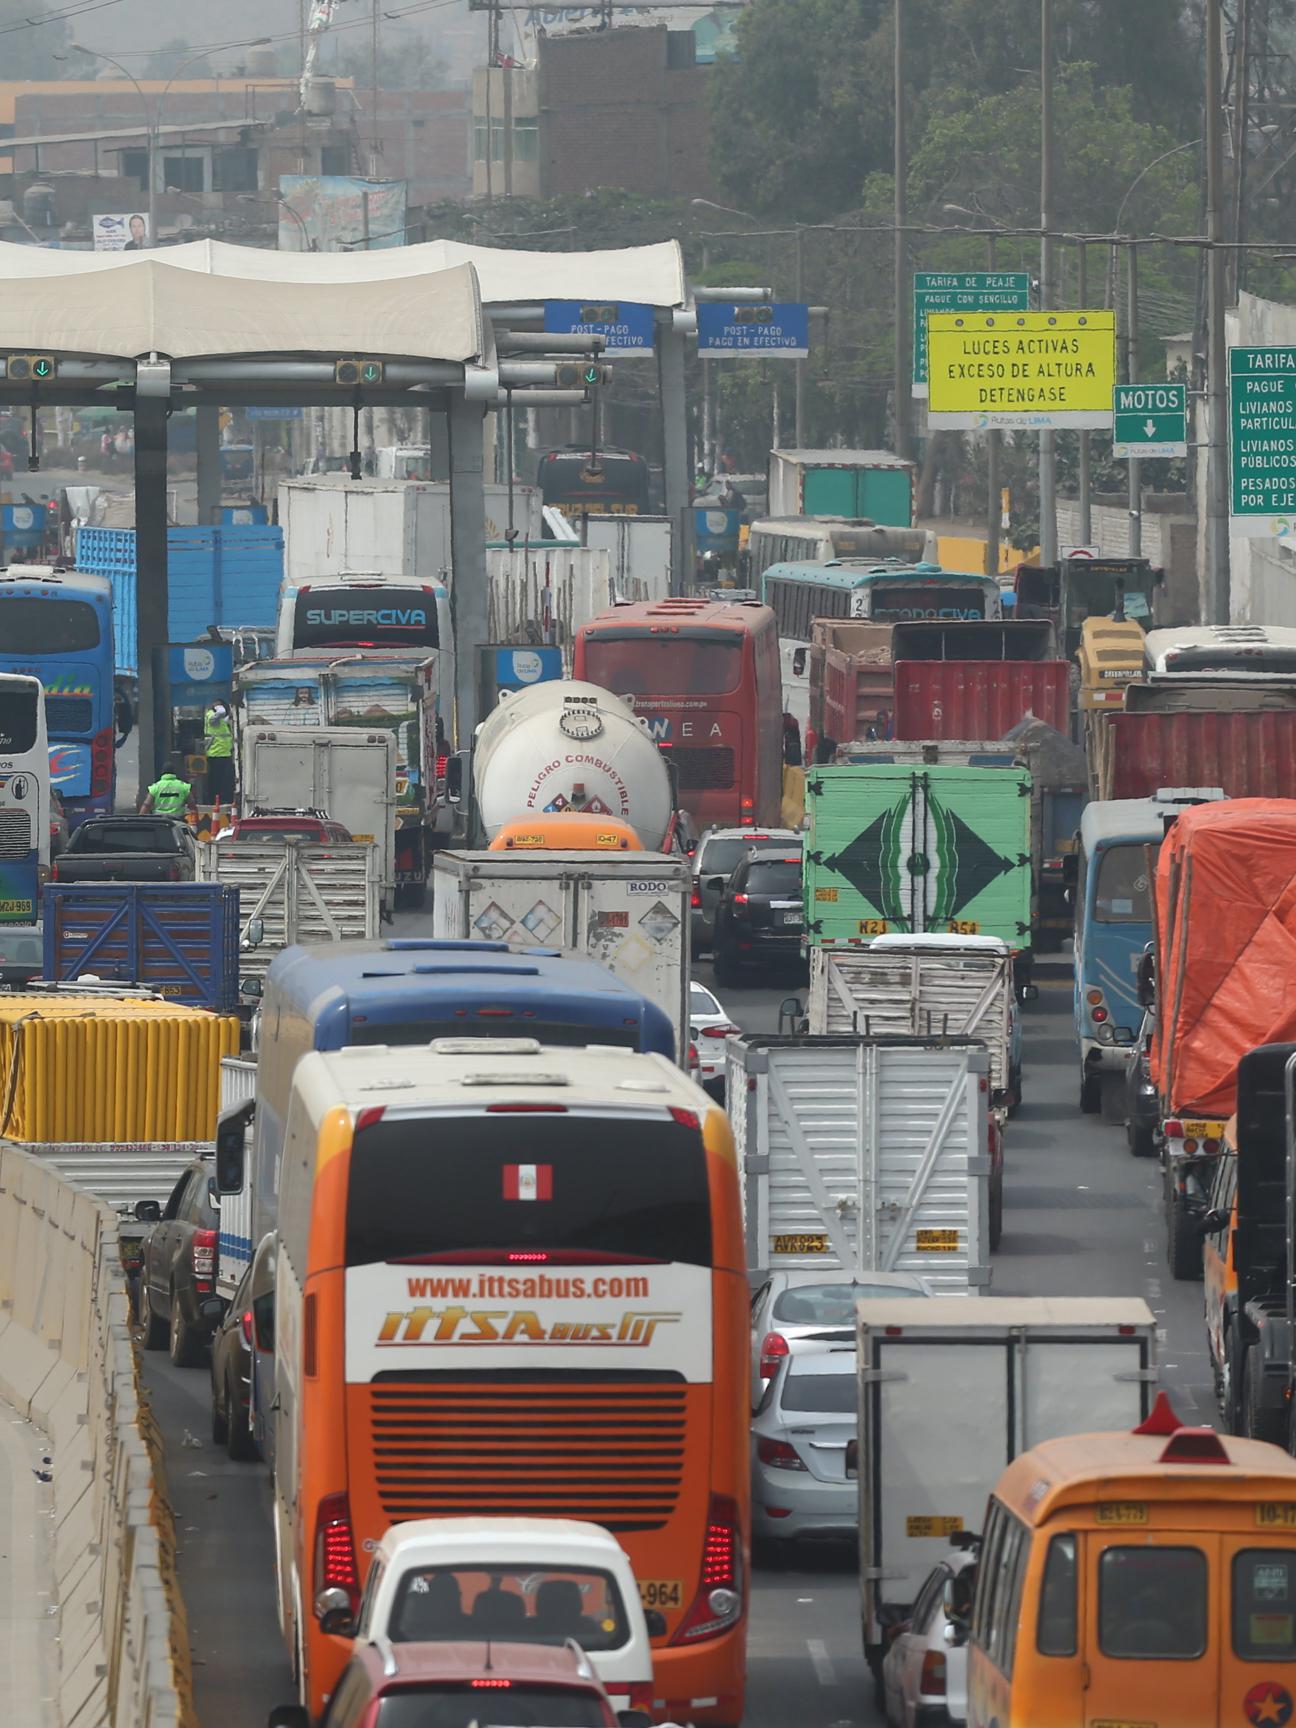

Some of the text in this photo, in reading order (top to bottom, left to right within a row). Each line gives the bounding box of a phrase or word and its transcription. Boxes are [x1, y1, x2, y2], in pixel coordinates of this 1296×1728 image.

[926, 276, 1015, 287] TARIFA DE PEAJE
[925, 295, 1018, 304] PAGUE CON SENCILLO
[605, 325, 629, 335] PAGO
[724, 326, 746, 335] POST
[758, 326, 782, 336] PAGO
[605, 336, 643, 346] FECTIVO
[708, 336, 797, 346] PAGO EN EFECTIVO
[963, 339, 1079, 355] LUCES ACTIVAS
[1247, 354, 1296, 368] TARIFA
[948, 362, 1095, 379] EXCESO DE ALTURA
[1247, 381, 1284, 393] PAGUE
[979, 387, 1067, 403] DETENGASE
[1120, 390, 1178, 409] MOTOS
[1239, 401, 1293, 414] LIVIANOS
[1028, 417, 1052, 425] LIMA
[1241, 439, 1294, 453] LIVIANOS
[1241, 454, 1296, 468] PÚBLICOS
[1241, 478, 1295, 490] PESADOS
[1241, 493, 1295, 506] POR EJE
[306, 609, 427, 625] SUPERCIVA
[527, 755, 629, 816] PELIGRO COMBUSTIBLE
[631, 882, 666, 891] RODO
[408, 1274, 649, 1299] www.ittsabus.com
[549, 1323, 616, 1340] BUS
